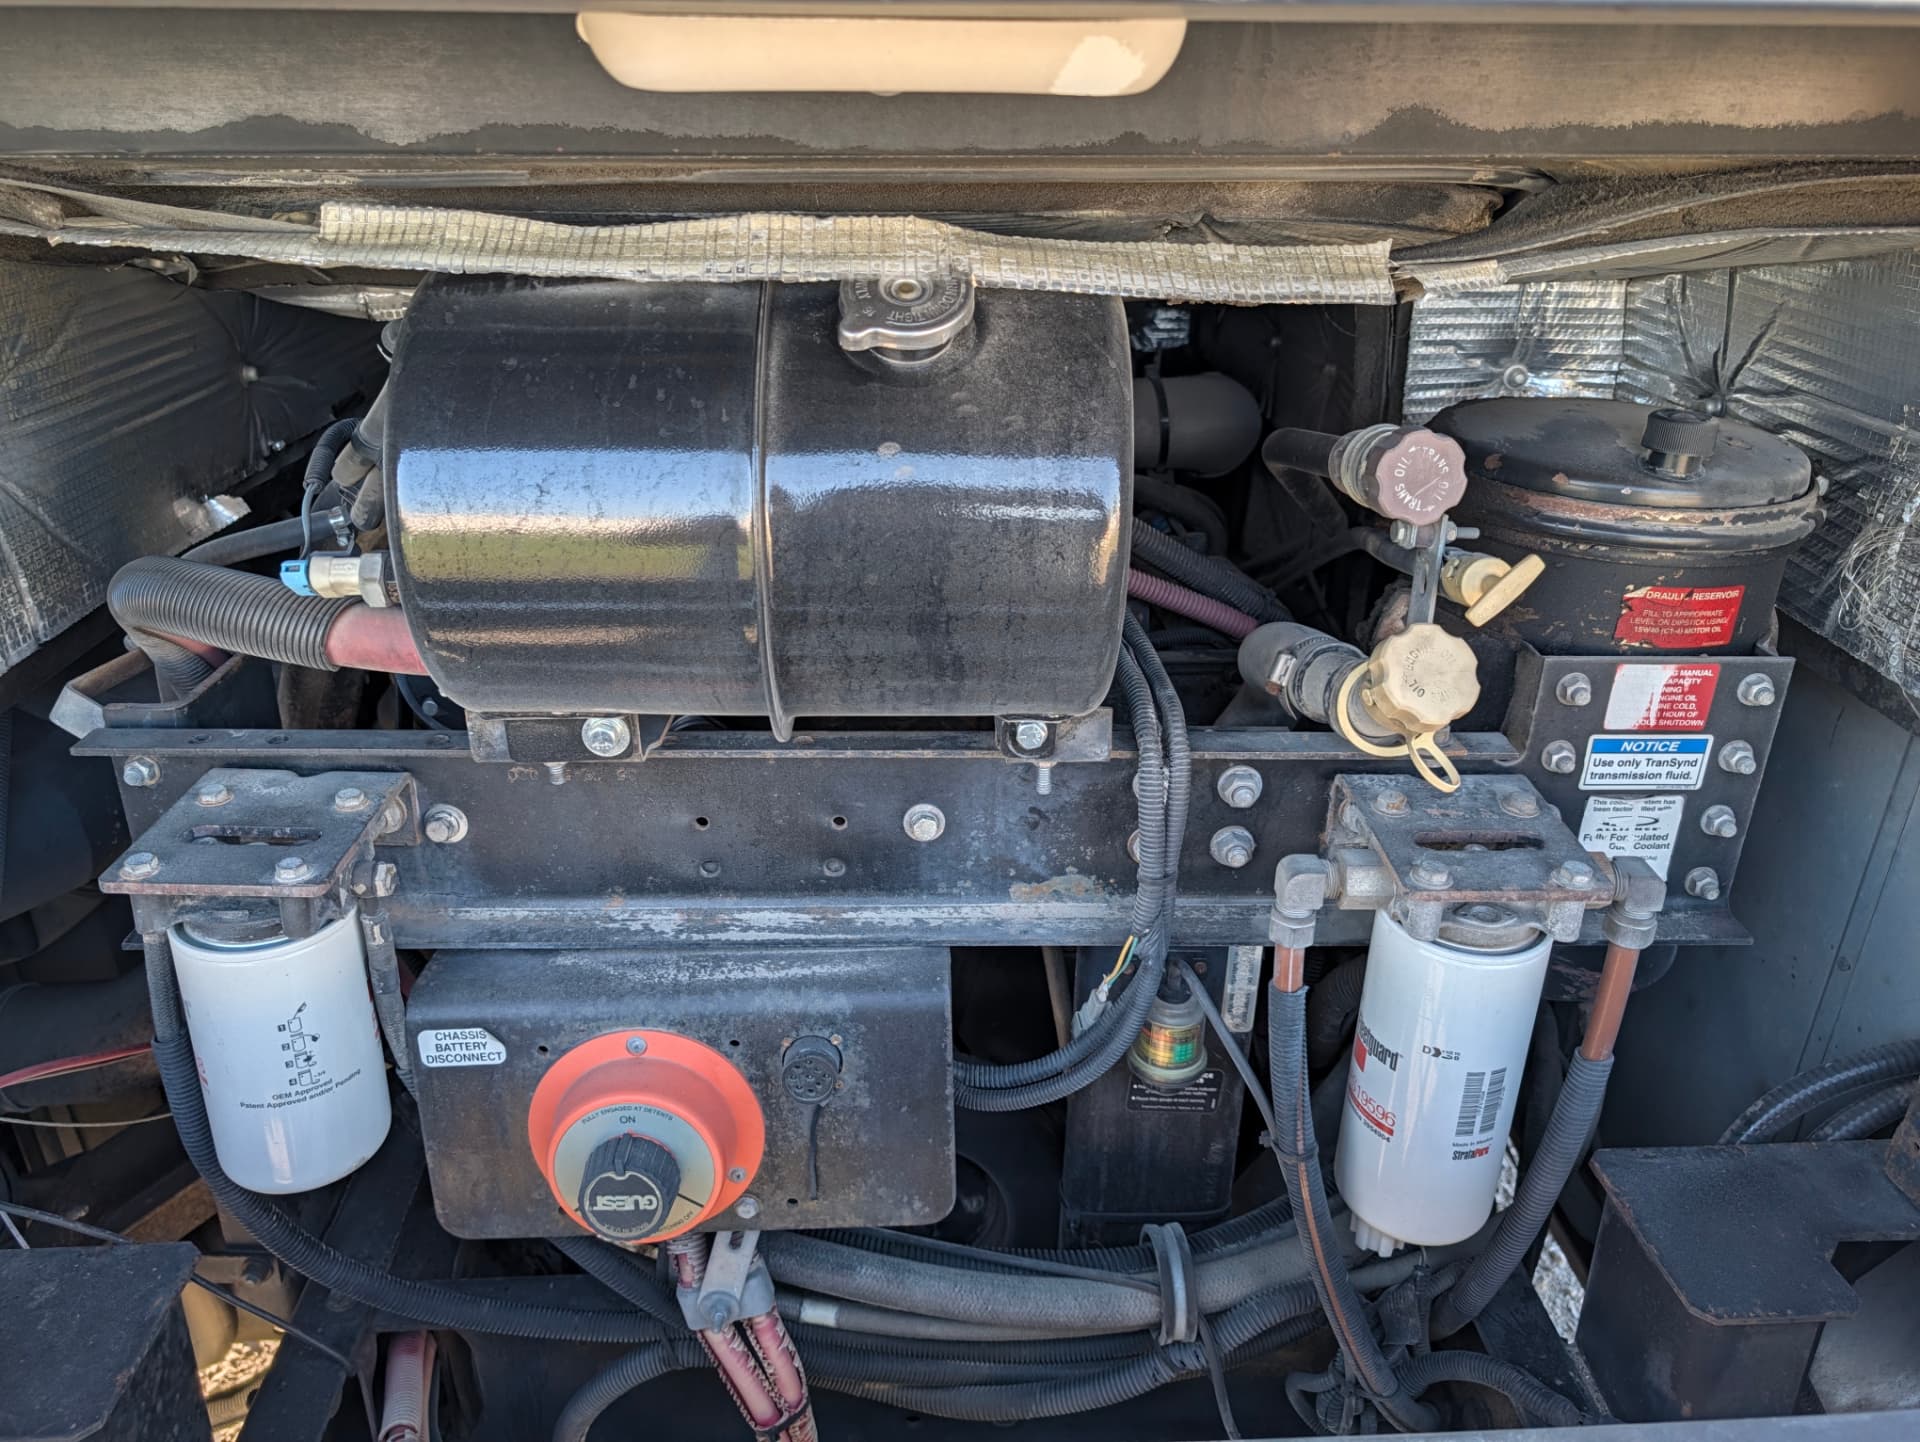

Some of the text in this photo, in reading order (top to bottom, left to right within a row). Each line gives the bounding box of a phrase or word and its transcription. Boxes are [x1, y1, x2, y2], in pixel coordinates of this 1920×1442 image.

[1422, 446, 1449, 474] TRANS
[1394, 456, 1422, 511] TRANS OIL
[1691, 590, 1740, 601] RESERVOIR
[1642, 609, 1659, 617] FILL
[1662, 610, 1673, 618] TO
[1630, 617, 1656, 626] LEVEL
[1658, 618, 1670, 626] ON
[1683, 626, 1710, 634] MOTOR
[1679, 669, 1714, 677] MANUAL
[1408, 678, 1426, 698] OIL
[1684, 694, 1697, 702] OIL
[1663, 711, 1686, 719] HOUR
[1686, 711, 1699, 719] OF
[1658, 719, 1705, 728] SHUTDOWN
[1620, 741, 1682, 752] NOTICE
[1592, 757, 1699, 771] Use only TranSynd
[1589, 770, 1693, 781] transmission fluid.
[1632, 842, 1671, 850] Coolant
[434, 1030, 487, 1041] CHASSIS
[435, 1041, 488, 1052] BATTERY
[426, 1051, 503, 1064] DISCONNECT
[272, 1078, 333, 1101] OEM Approved
[239, 1101, 265, 1110] Patent
[266, 1095, 307, 1109] Approved
[308, 1086, 334, 1100] and/or
[581, 1111, 600, 1124] FULLY
[600, 1105, 632, 1115] ENGAGED
[643, 1106, 673, 1121] DETENTS
[619, 1115, 637, 1124] ON
[592, 1194, 658, 1211] GUEST
